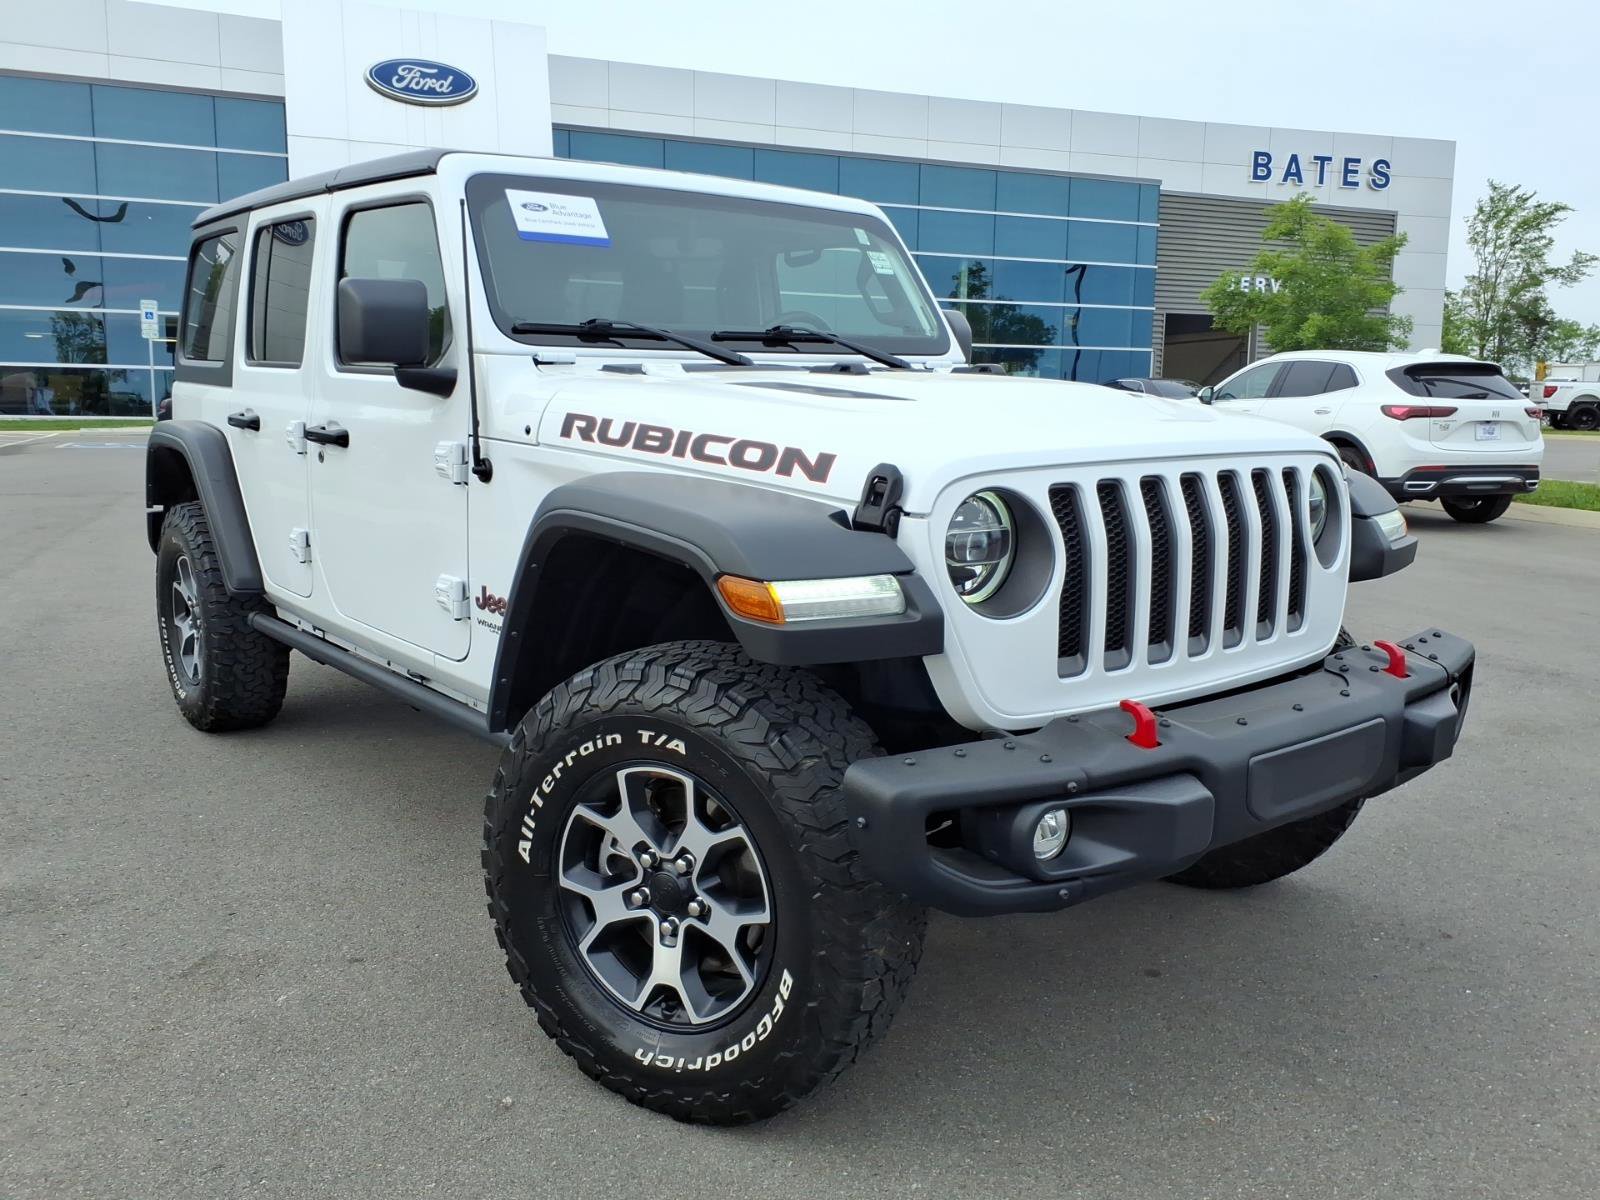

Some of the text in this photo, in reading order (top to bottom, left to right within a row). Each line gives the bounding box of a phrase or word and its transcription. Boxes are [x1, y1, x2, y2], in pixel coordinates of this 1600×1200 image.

[391, 64, 454, 93] Ford
[1249, 151, 1391, 190] BATES
[560, 412, 837, 484] RUBICON
[475, 585, 507, 617] Jee
[518, 729, 687, 864] All-Terrain T/A
[634, 968, 794, 1073] BFGoodrich
